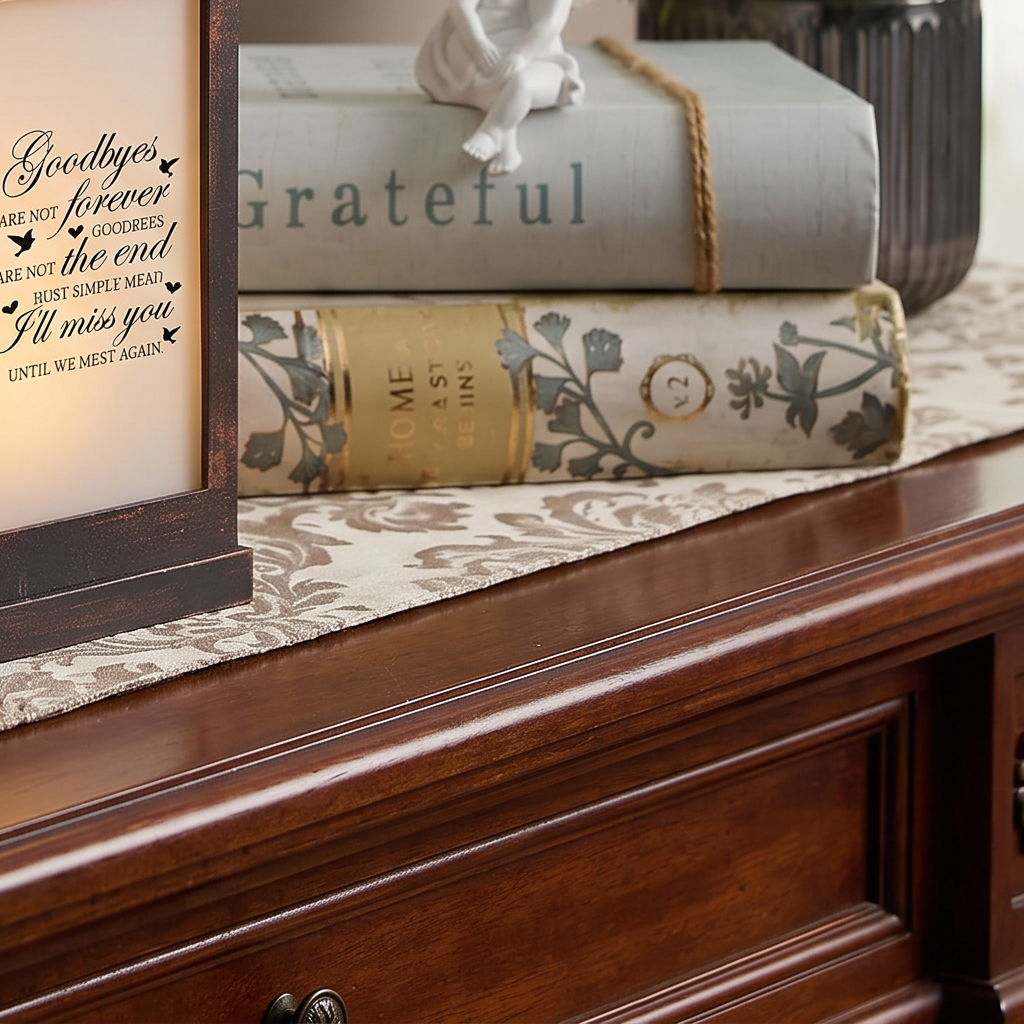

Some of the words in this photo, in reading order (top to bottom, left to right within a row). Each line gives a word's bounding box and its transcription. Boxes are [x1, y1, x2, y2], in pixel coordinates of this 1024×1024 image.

[2, 130, 158, 198] Goodbyes
[29, 206, 59, 224] NOT
[47, 178, 171, 239] forever
[238, 162, 585, 229] Grateful
[26, 261, 56, 280] NOT
[61, 236, 108, 277] the
[113, 221, 178, 267] end
[92, 215, 165, 238] GOODREES
[59, 305, 117, 339] miss
[112, 300, 175, 347] you
[8, 362, 51, 382] UNTIL
[54, 357, 76, 373] WE
[79, 349, 116, 369] MEST
[119, 341, 164, 361] AGAIN.
